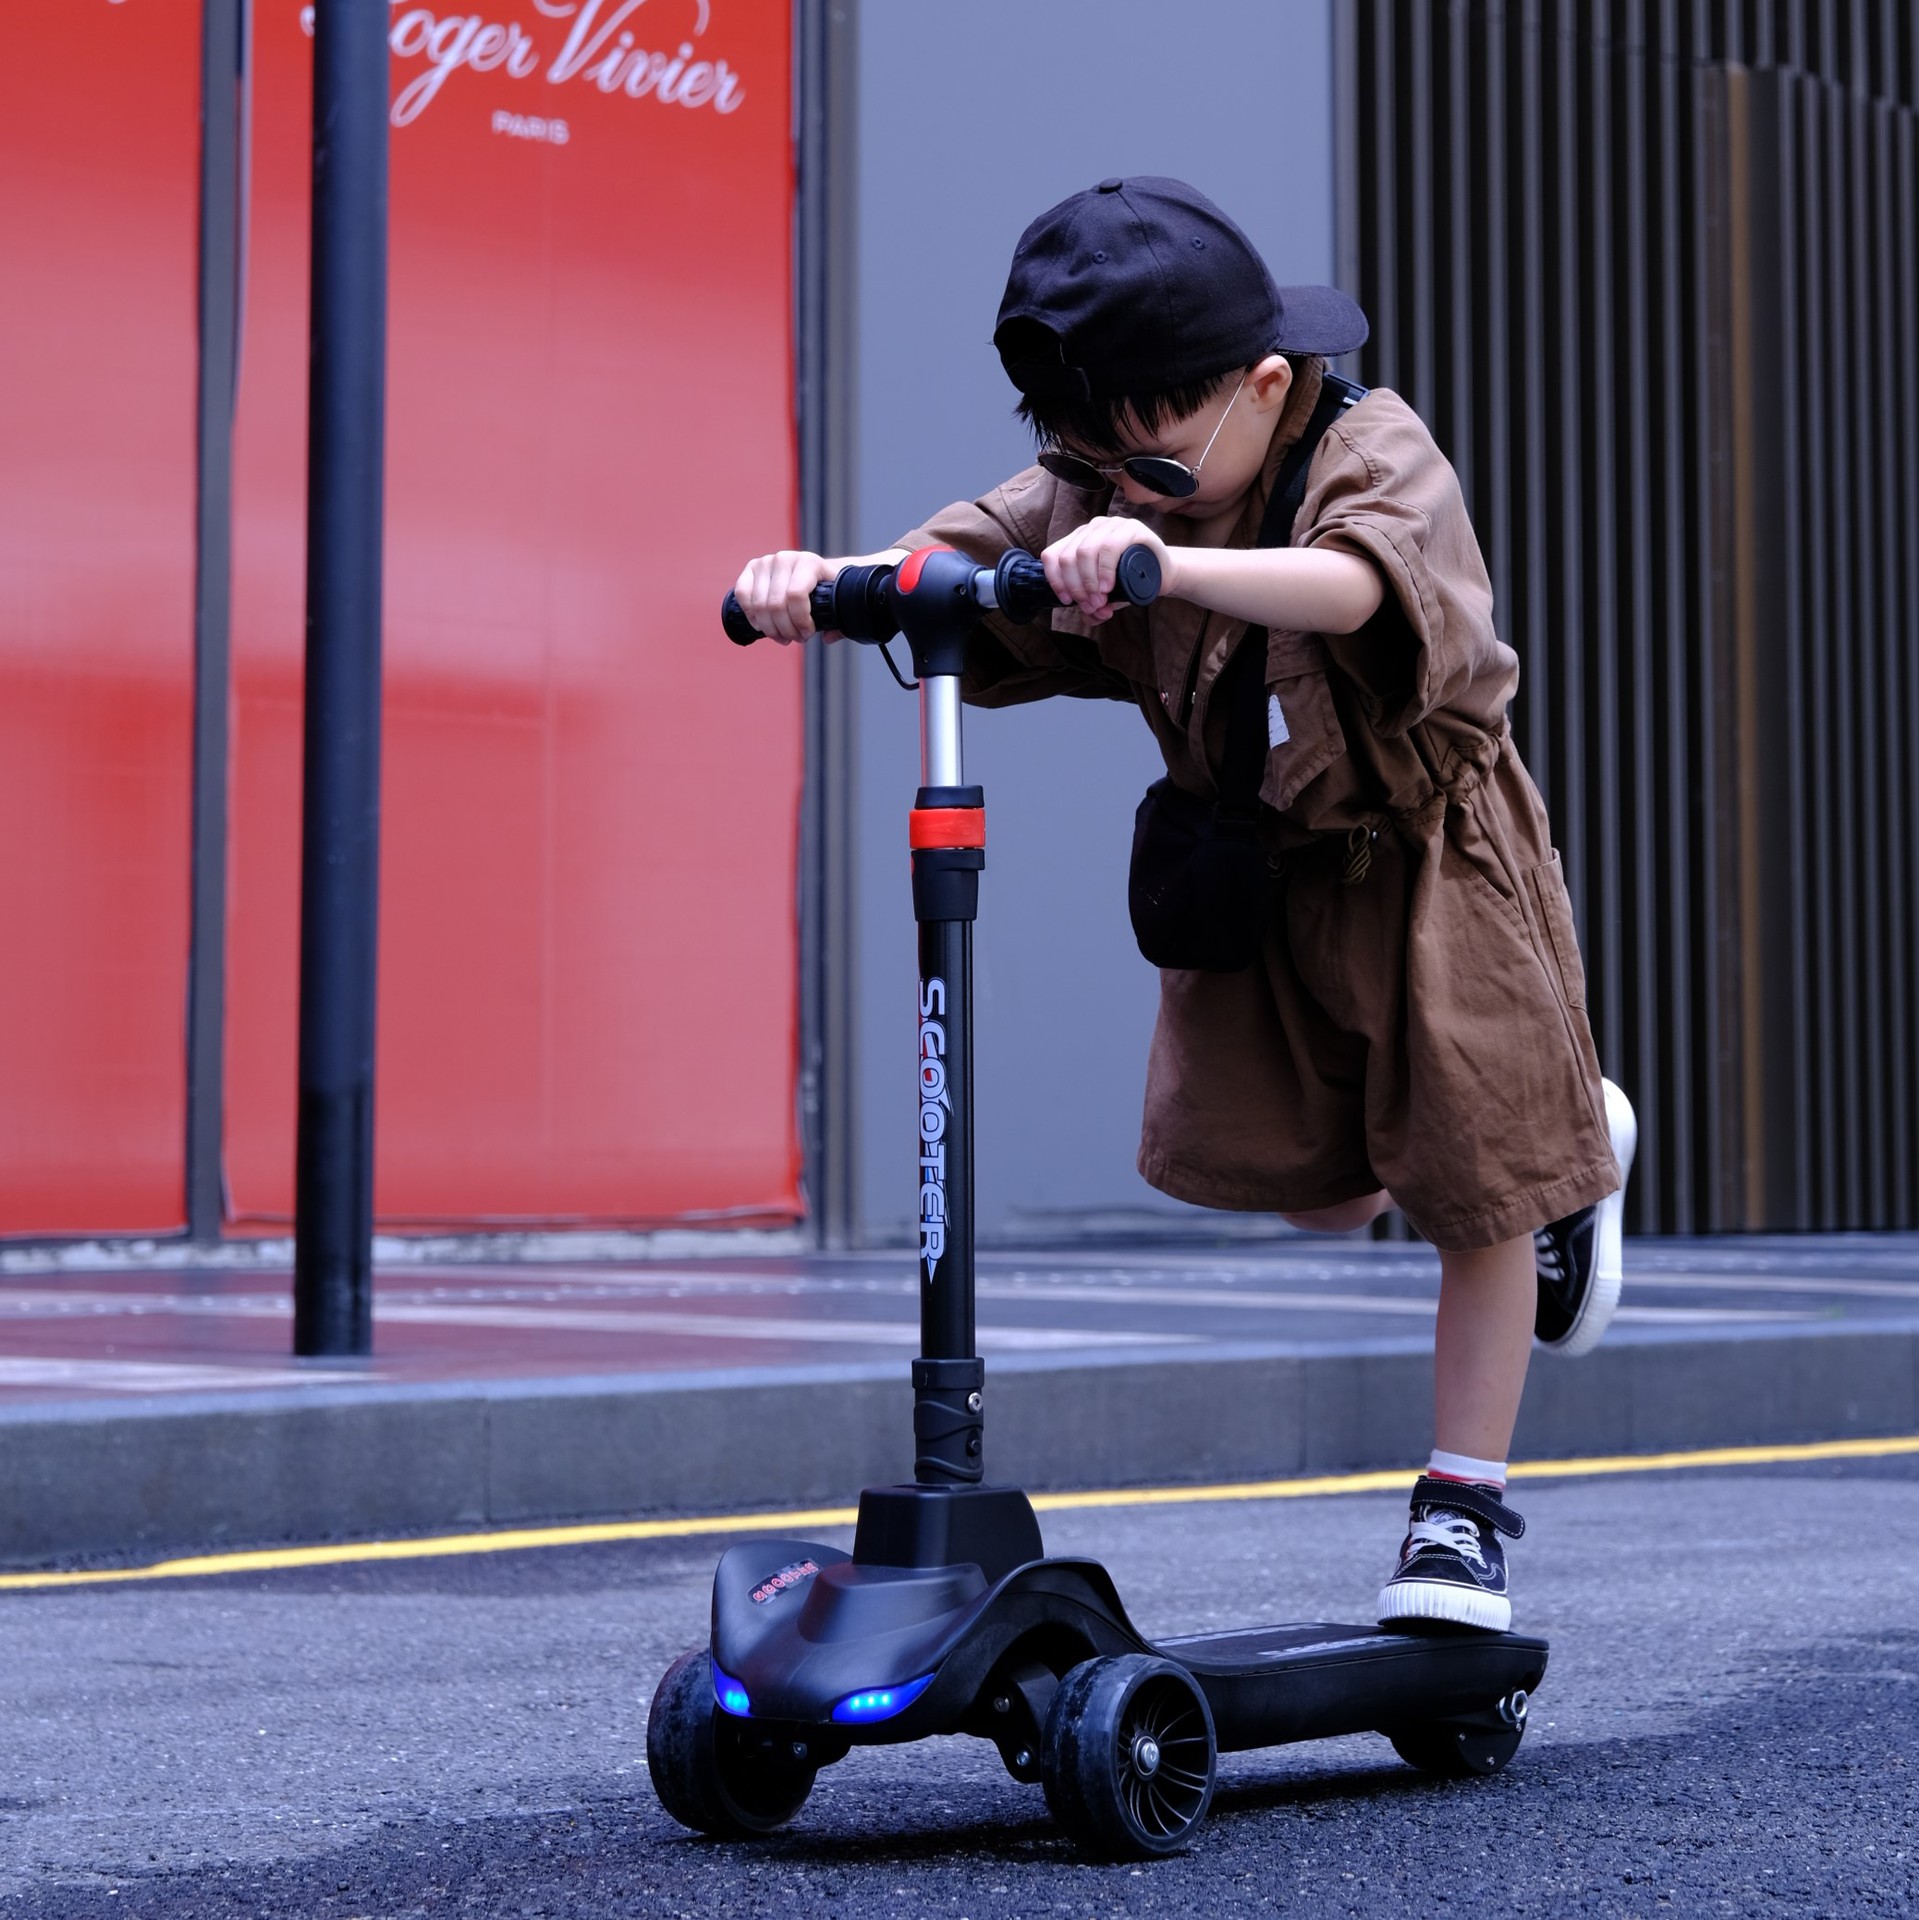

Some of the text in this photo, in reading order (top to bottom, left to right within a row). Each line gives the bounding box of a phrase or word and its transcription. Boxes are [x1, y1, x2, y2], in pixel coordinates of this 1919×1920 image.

[300, 0, 745, 128] oger Vivier
[491, 110, 569, 145] PARIS
[918, 976, 949, 1261] SCOOTER
